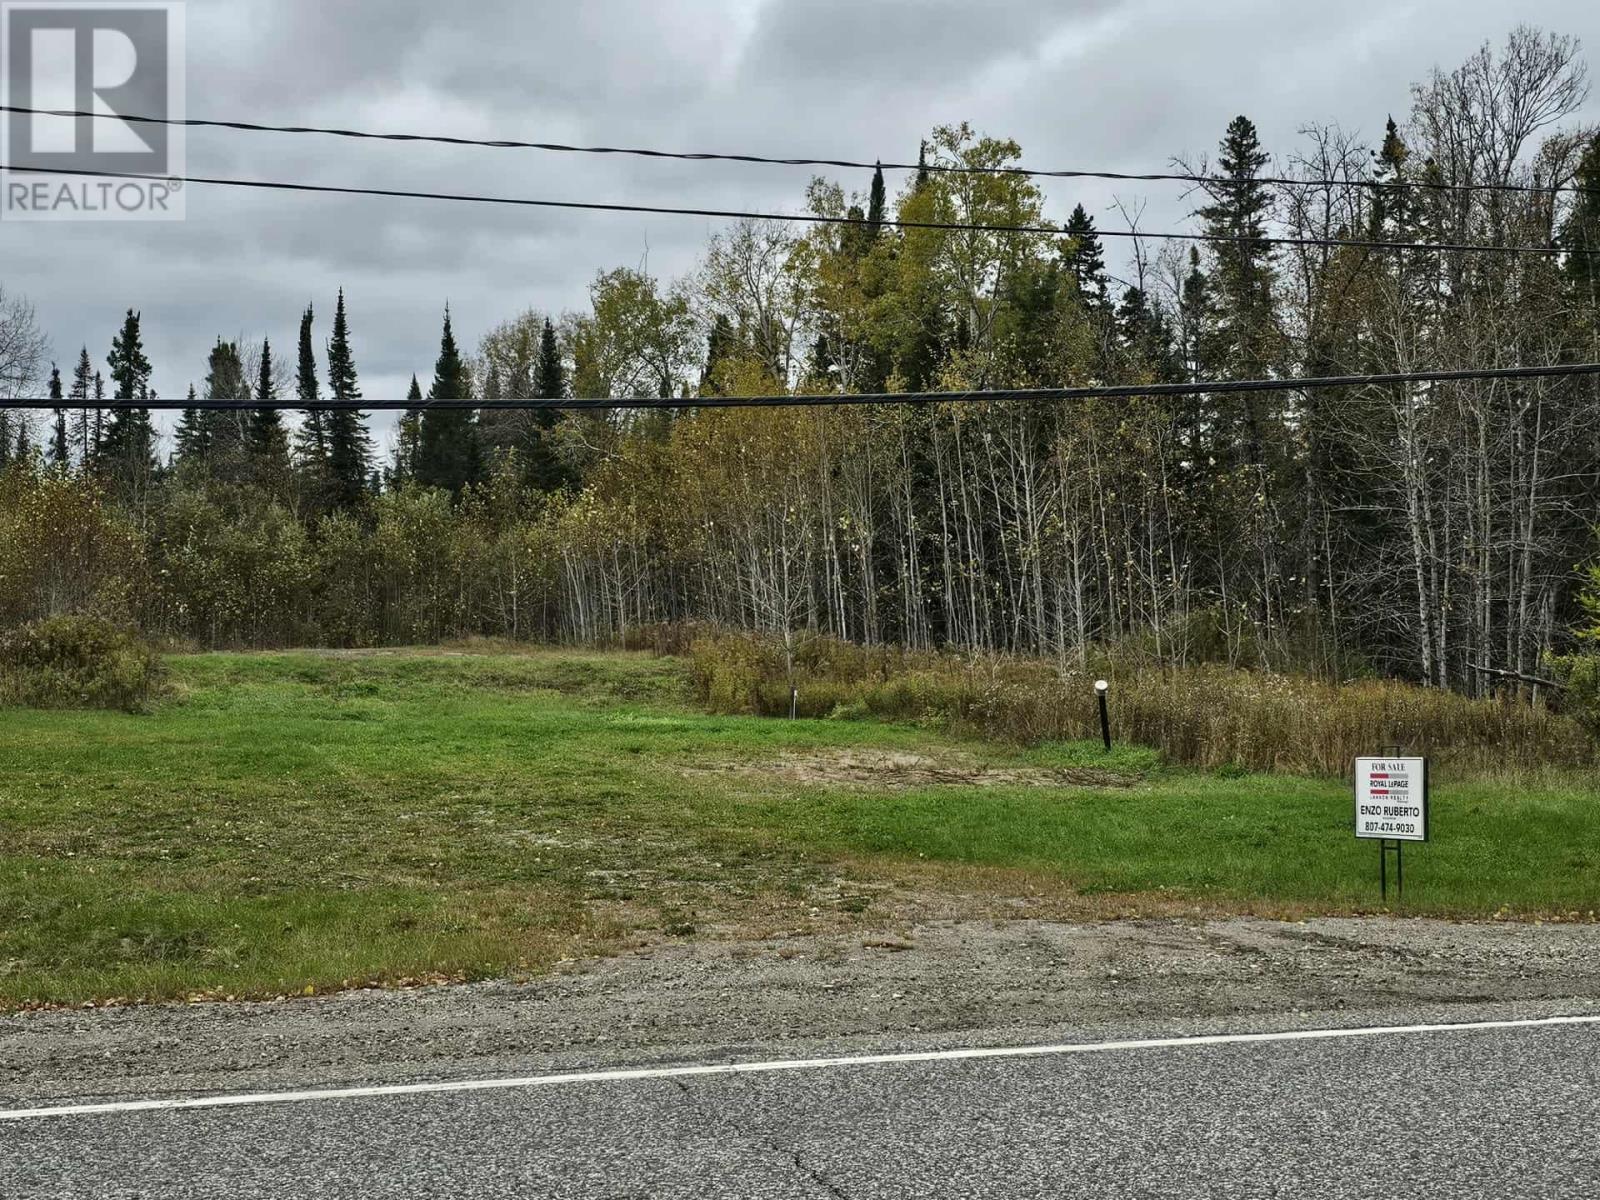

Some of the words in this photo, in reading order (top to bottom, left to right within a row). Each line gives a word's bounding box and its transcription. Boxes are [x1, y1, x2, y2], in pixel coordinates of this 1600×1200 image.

[1372, 763, 1386, 771] FOR
[1388, 763, 1405, 771] SALE
[1361, 806, 1381, 815] ENZO
[1384, 807, 1419, 817] RUBERTO
[1365, 822, 1414, 833] 807-474-9030
